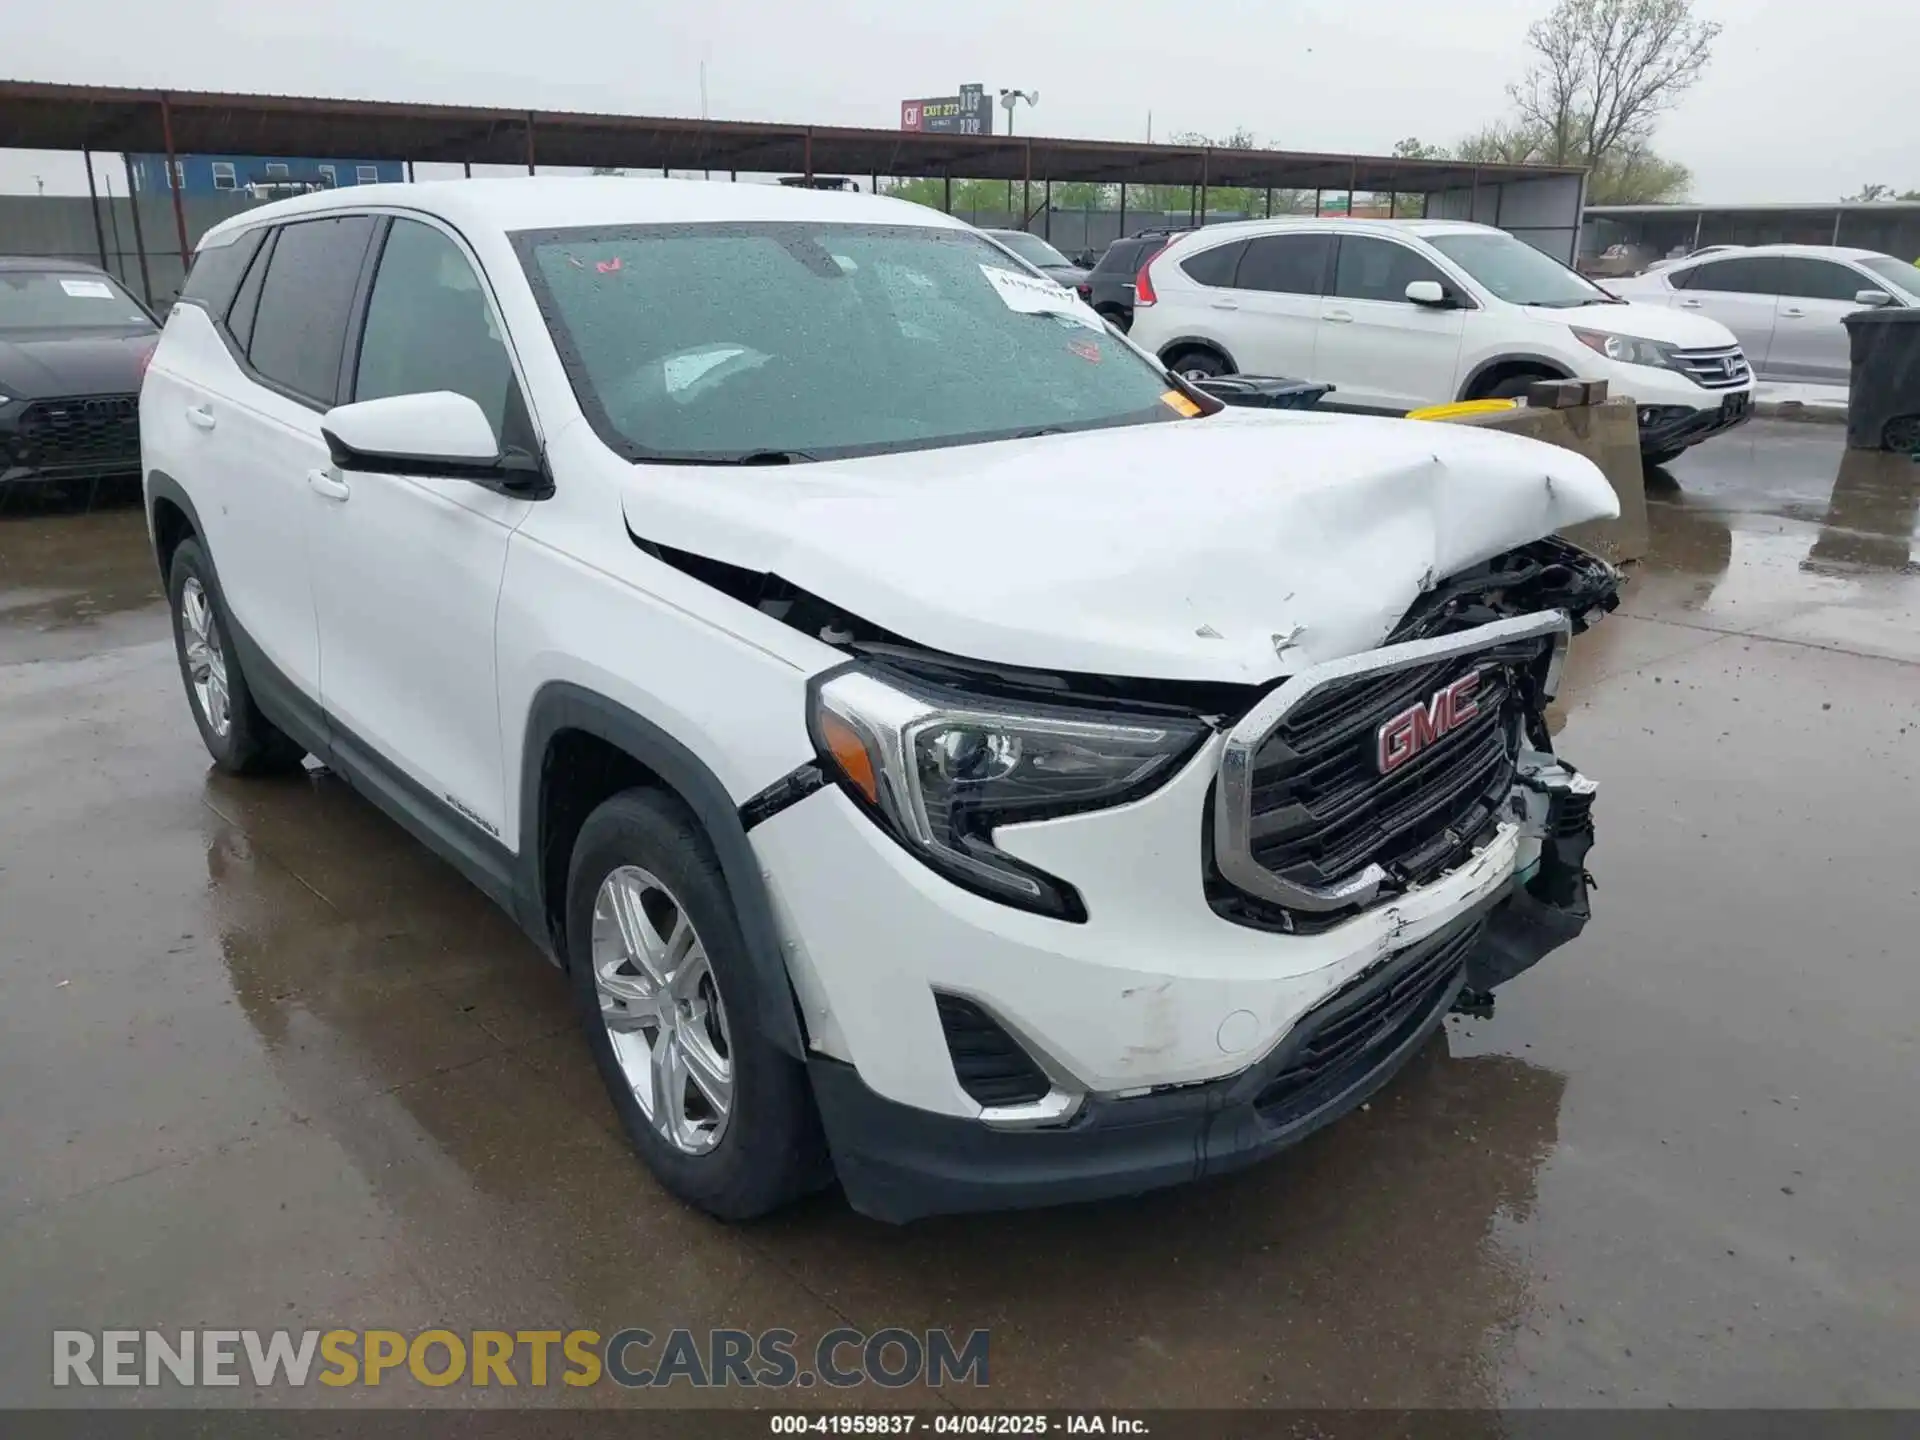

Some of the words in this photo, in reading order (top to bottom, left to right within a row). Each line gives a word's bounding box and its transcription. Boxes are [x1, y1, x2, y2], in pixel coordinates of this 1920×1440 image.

[904, 107, 919, 125] QT
[923, 104, 941, 117] EXIT
[943, 103, 960, 116] 273
[1378, 669, 1480, 775] GMC
